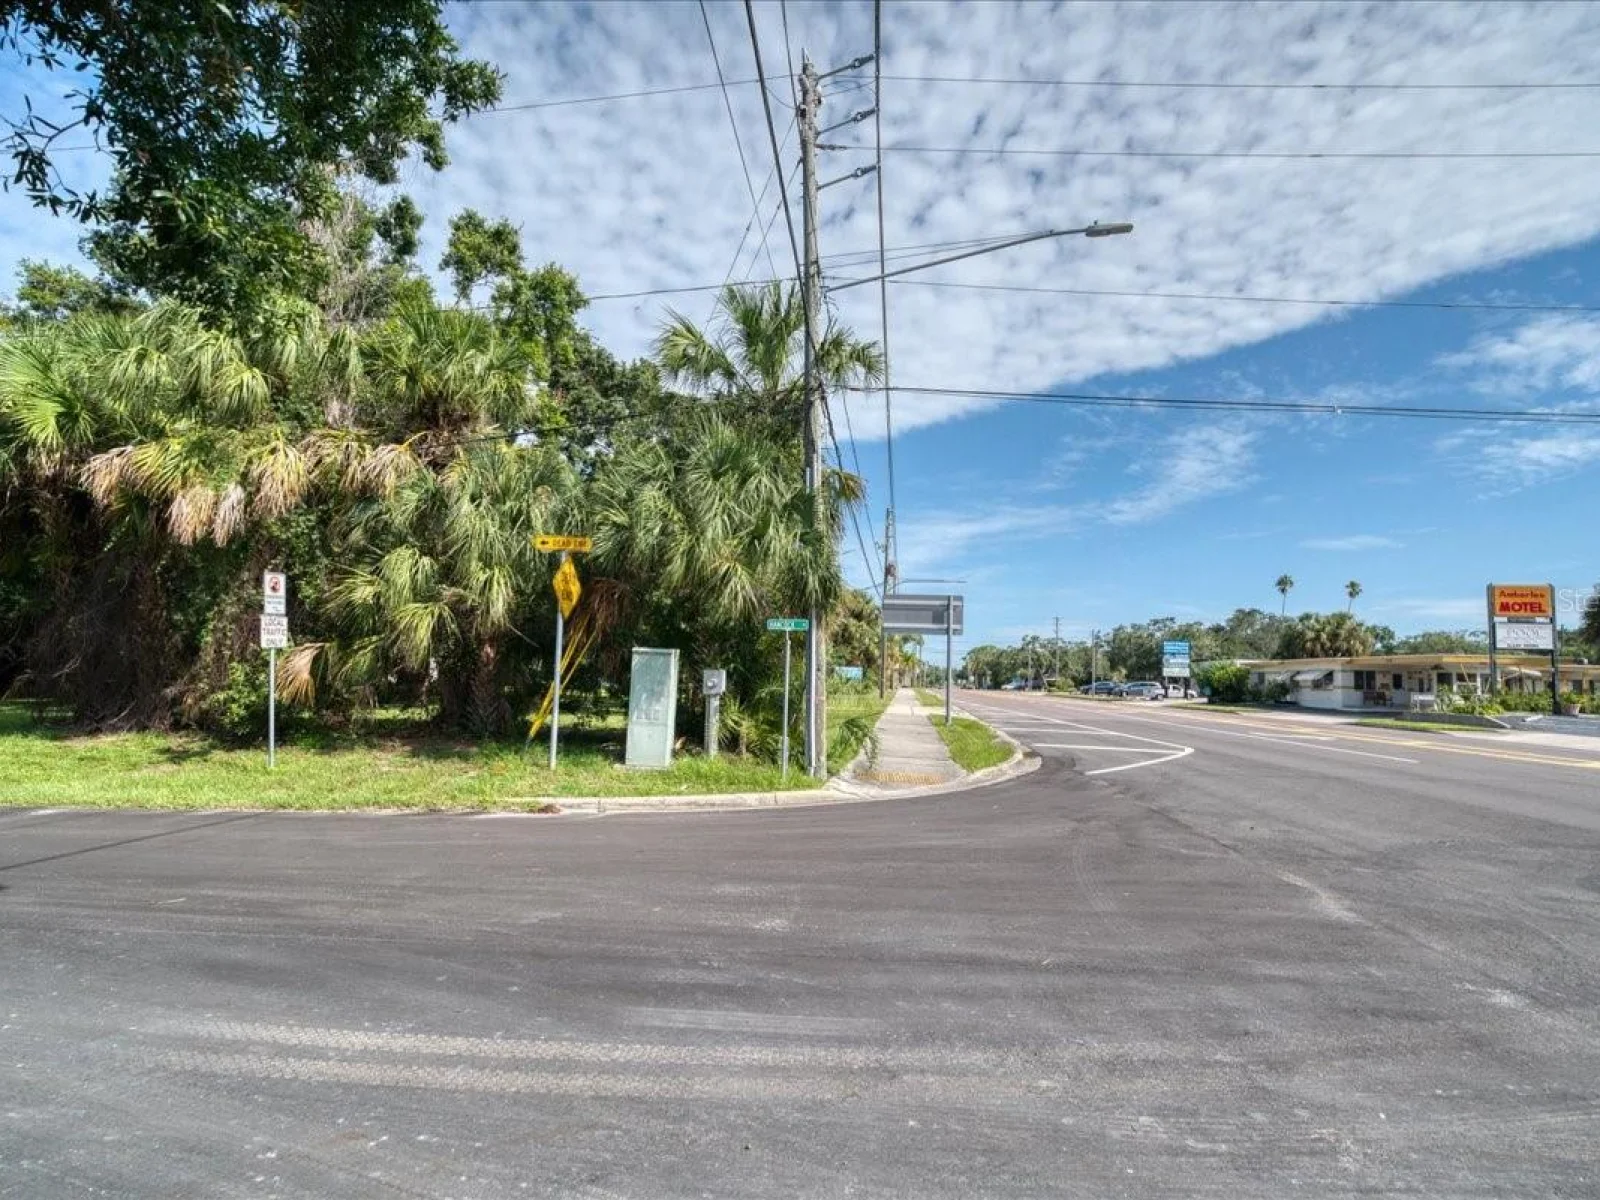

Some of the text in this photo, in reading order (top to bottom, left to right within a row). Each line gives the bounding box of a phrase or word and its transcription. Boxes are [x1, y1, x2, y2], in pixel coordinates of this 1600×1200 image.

[1499, 601, 1547, 613] MOTEL
[264, 617, 284, 626] LOCAL
[262, 627, 286, 636] TRAFFIC
[265, 637, 284, 646] ONLY
